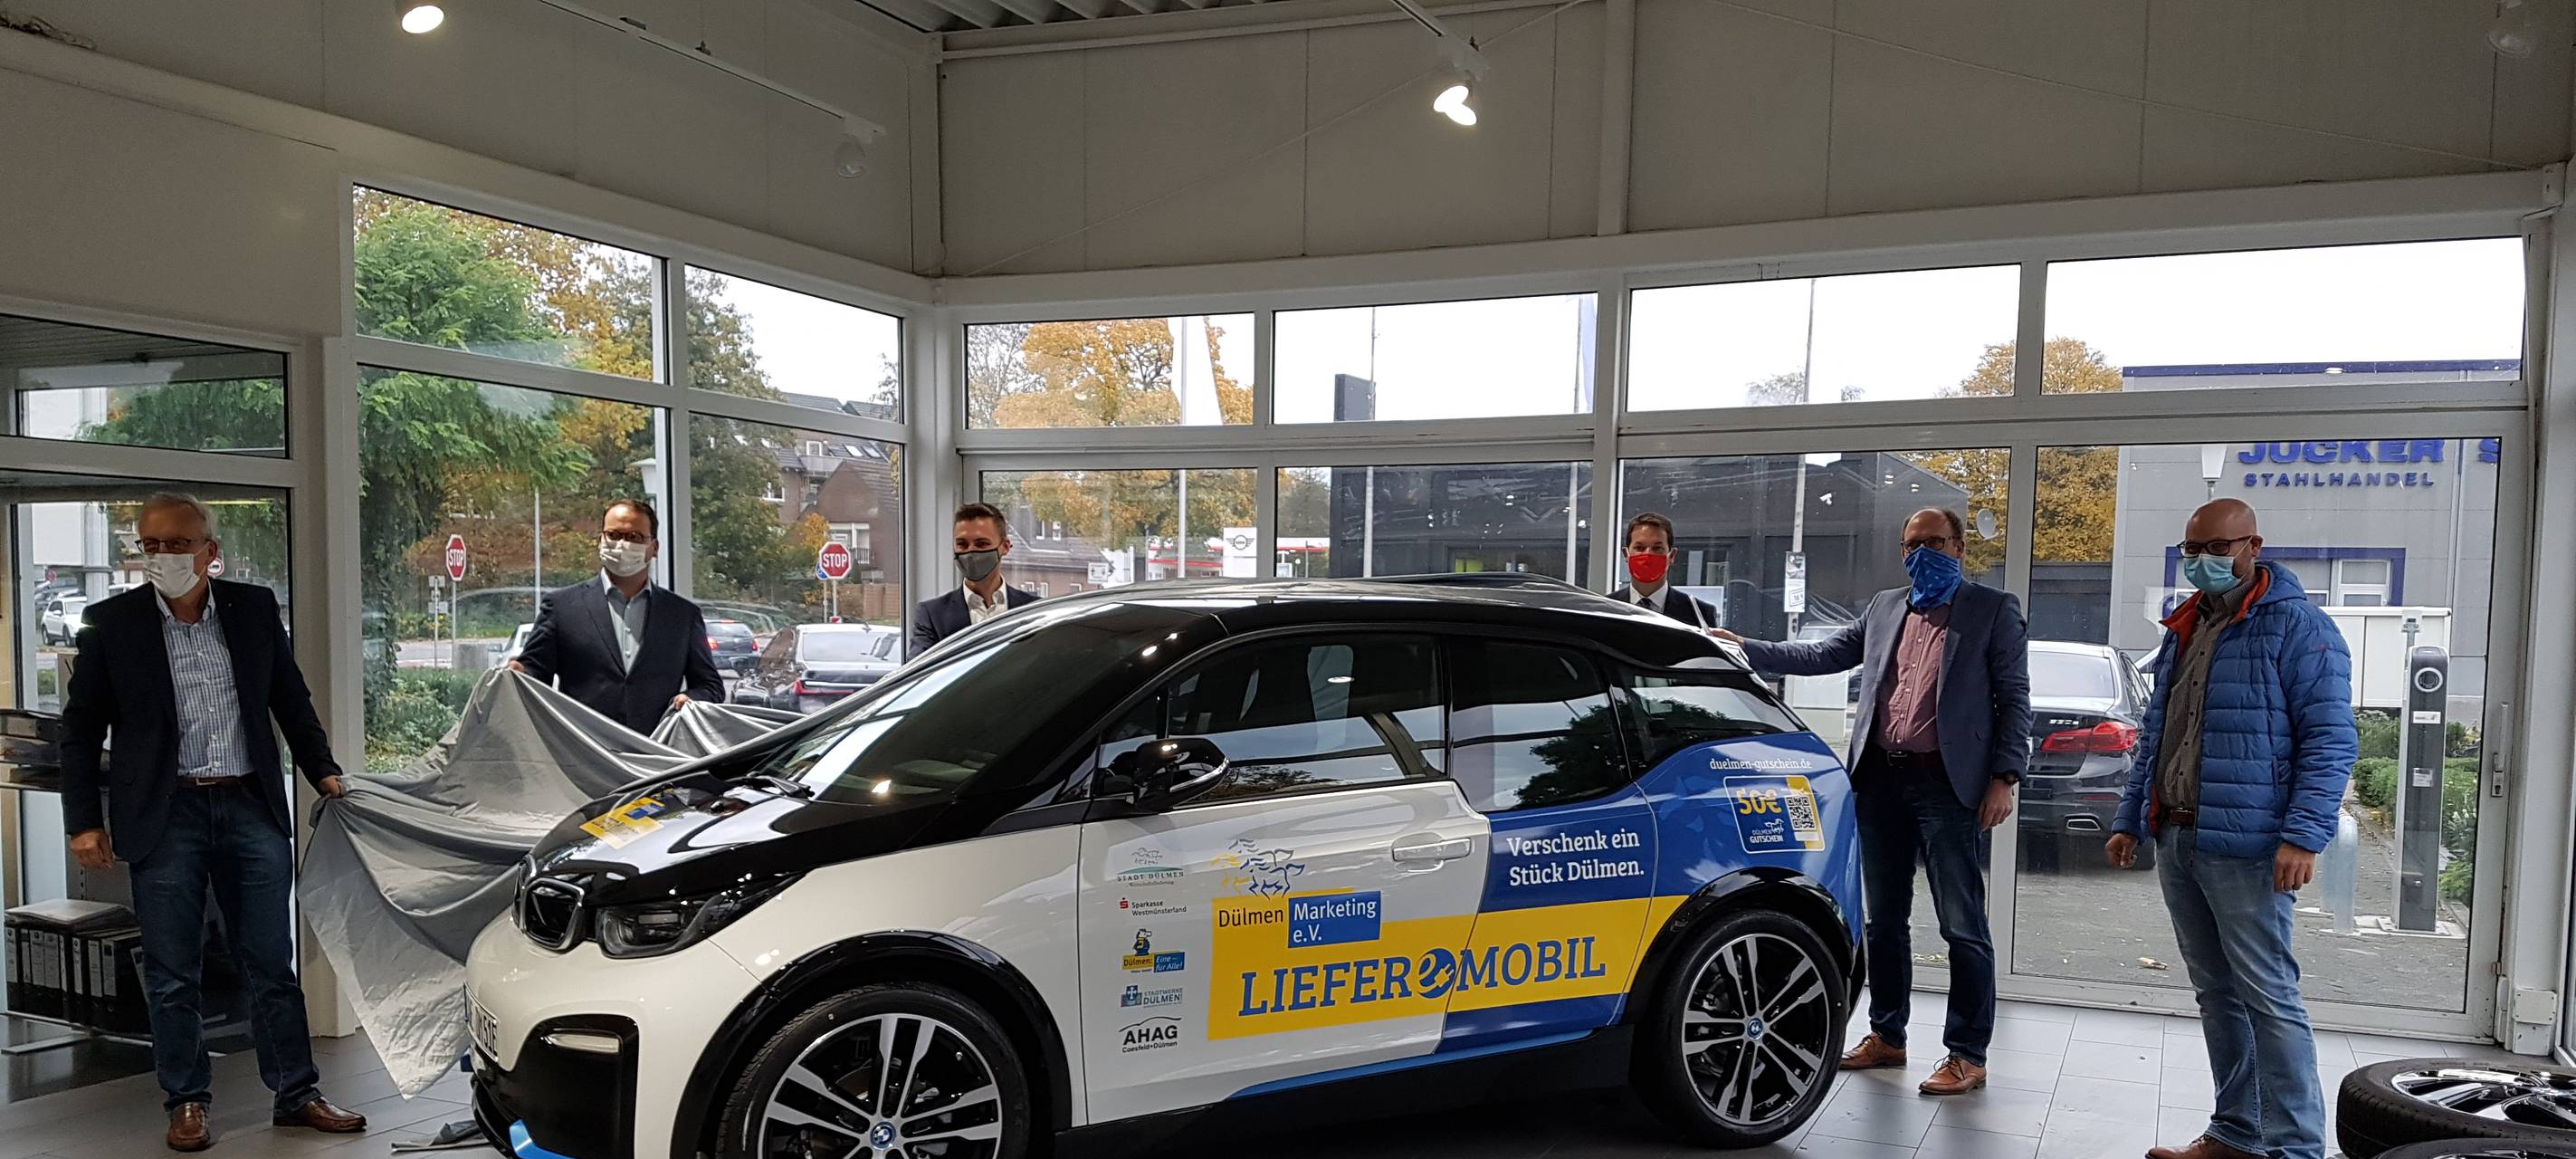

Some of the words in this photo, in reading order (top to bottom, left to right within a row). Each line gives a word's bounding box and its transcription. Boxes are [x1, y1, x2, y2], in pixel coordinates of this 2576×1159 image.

[2244, 472, 2435, 487] STAHLHANDEL
[449, 549, 463, 566] STOP
[823, 553, 848, 568] STOP
[1710, 758, 1811, 771] duelmen-gutschein.de
[1736, 788, 1782, 815] 50€
[1506, 829, 1608, 857] Verschenk
[1611, 828, 1640, 848] ein
[1750, 835, 1784, 844] GUTSCHEIN
[1117, 875, 1145, 883] STADT
[1510, 862, 1564, 886] Stück
[1567, 858, 1645, 881] Dülmen.
[1131, 900, 1163, 909] Sparkasse
[1131, 906, 1187, 916] Westmünsterland
[1219, 908, 1283, 927] Dülmen
[1293, 899, 1377, 921] Marketing
[1293, 924, 1322, 943] e.V.
[1122, 1025, 1178, 1046] AHAG
